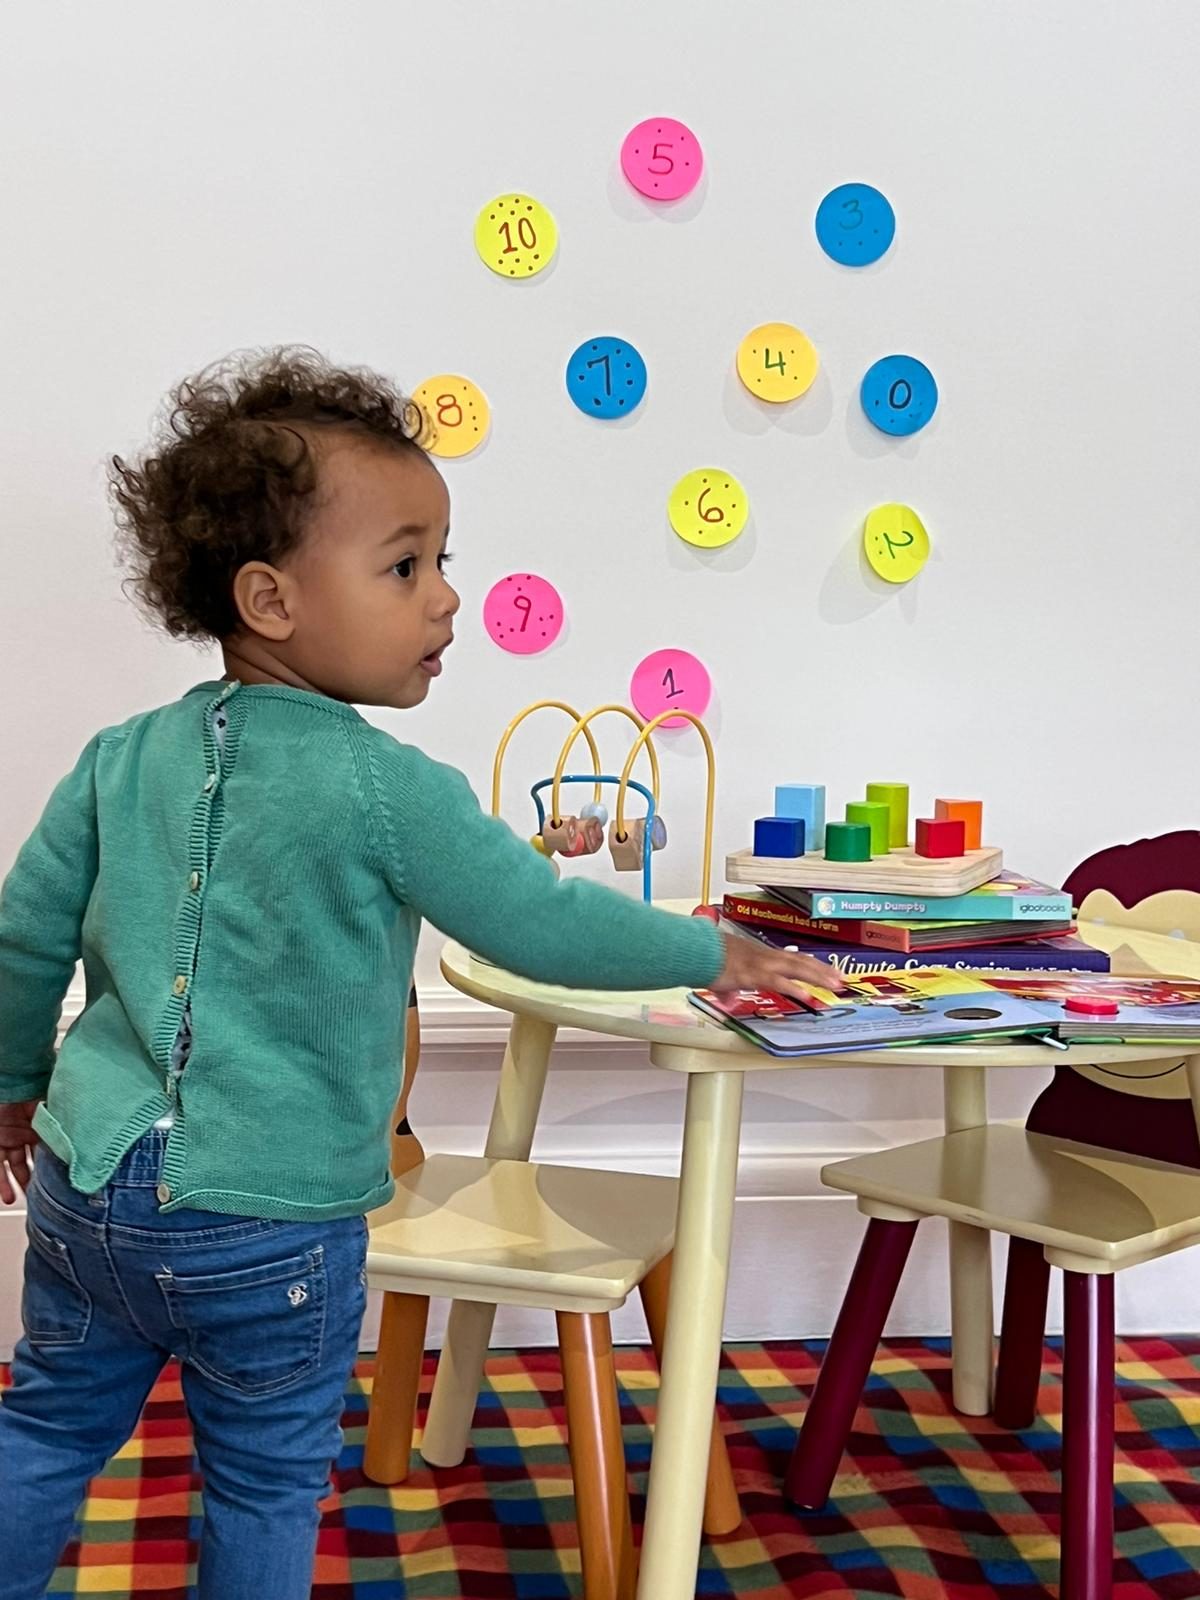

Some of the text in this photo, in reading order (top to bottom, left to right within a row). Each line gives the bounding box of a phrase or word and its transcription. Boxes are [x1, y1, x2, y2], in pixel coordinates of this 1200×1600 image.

[647, 142, 675, 176] 5
[839, 199, 864, 230] 3
[497, 216, 538, 256] 10
[586, 354, 613, 397] 7
[763, 347, 788, 377] 4
[435, 393, 463, 428] 8
[887, 378, 913, 412] 0
[697, 487, 725, 524] 6
[882, 530, 915, 560] 2
[513, 594, 532, 633] 9
[661, 667, 685, 699] 1
[737, 904, 751, 916] Old
[794, 915, 811, 928] had
[811, 920, 818, 929] a
[818, 921, 840, 933] Farm
[840, 900, 926, 914] Humpty Dumpty
